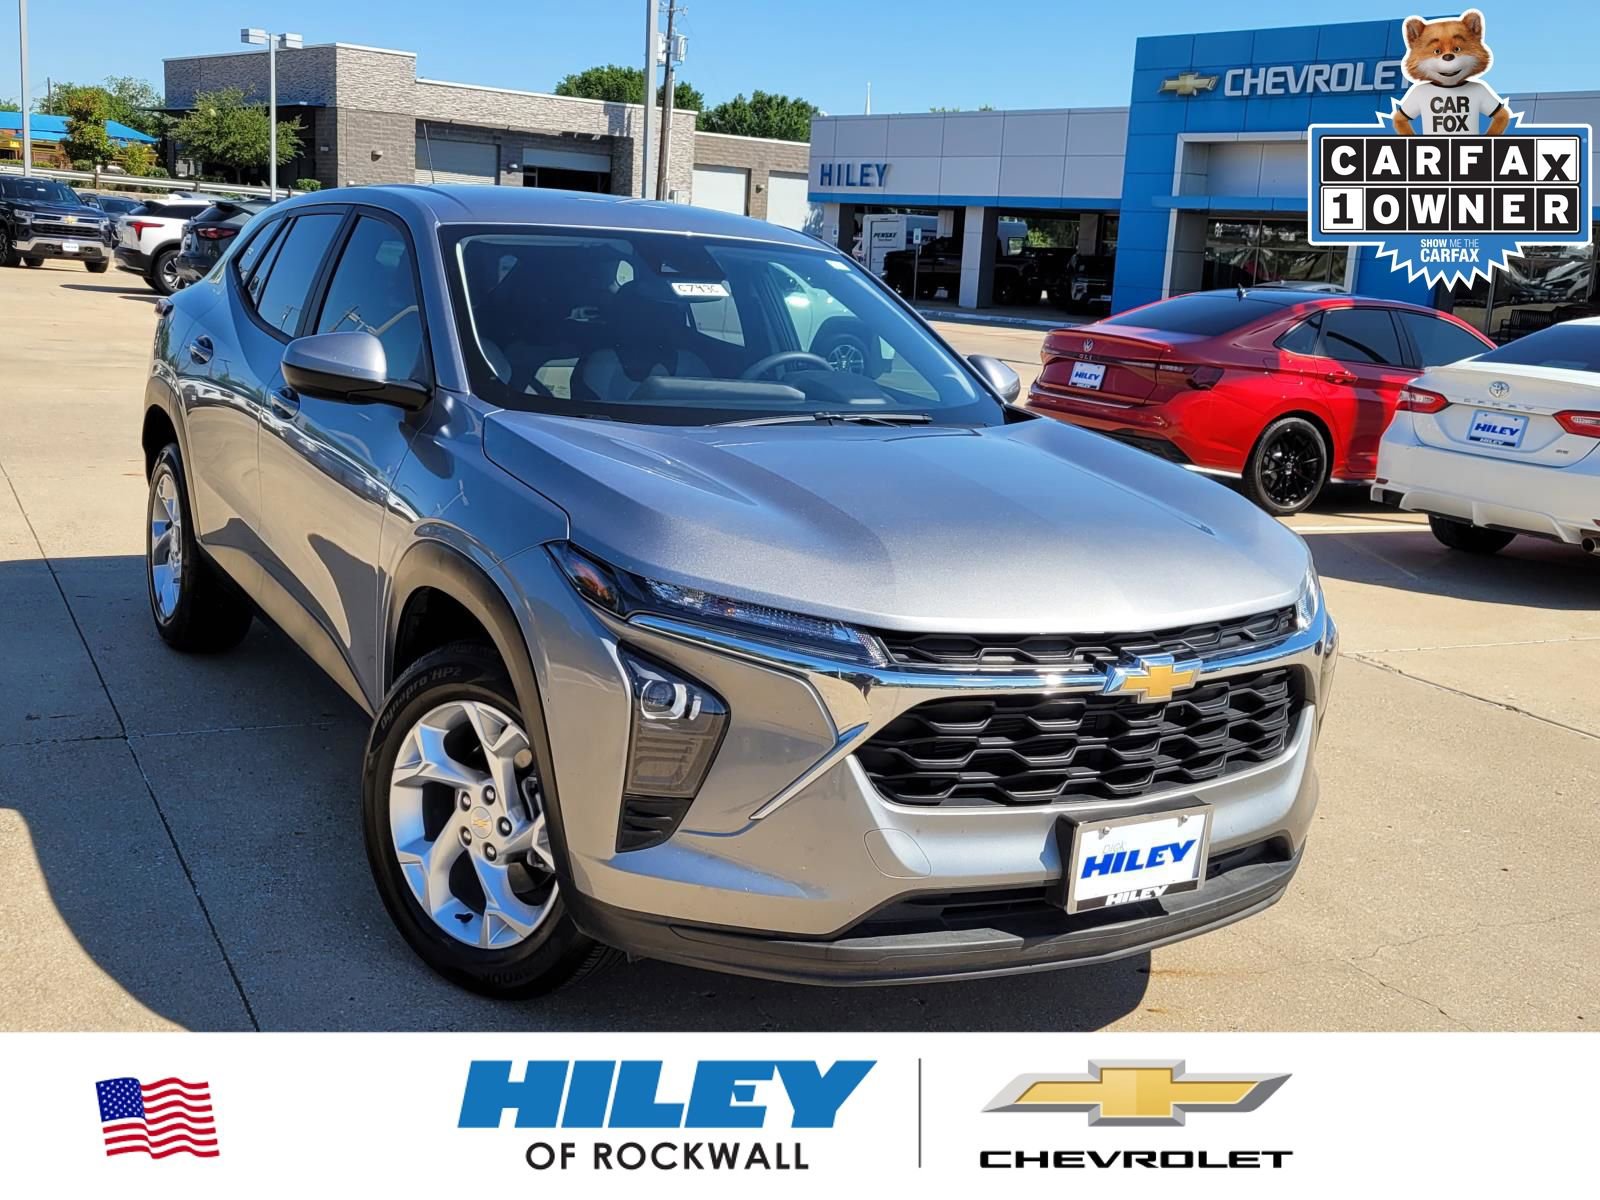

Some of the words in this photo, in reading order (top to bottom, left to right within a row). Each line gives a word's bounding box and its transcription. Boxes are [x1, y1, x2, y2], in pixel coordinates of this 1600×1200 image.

[1223, 60, 1409, 97] CHEVROLE
[819, 163, 889, 188] HILEY
[1074, 371, 1101, 381] HILEY
[1474, 422, 1520, 437] HILEY
[1080, 839, 1197, 880] HILEY
[1104, 884, 1169, 906] HILEY
